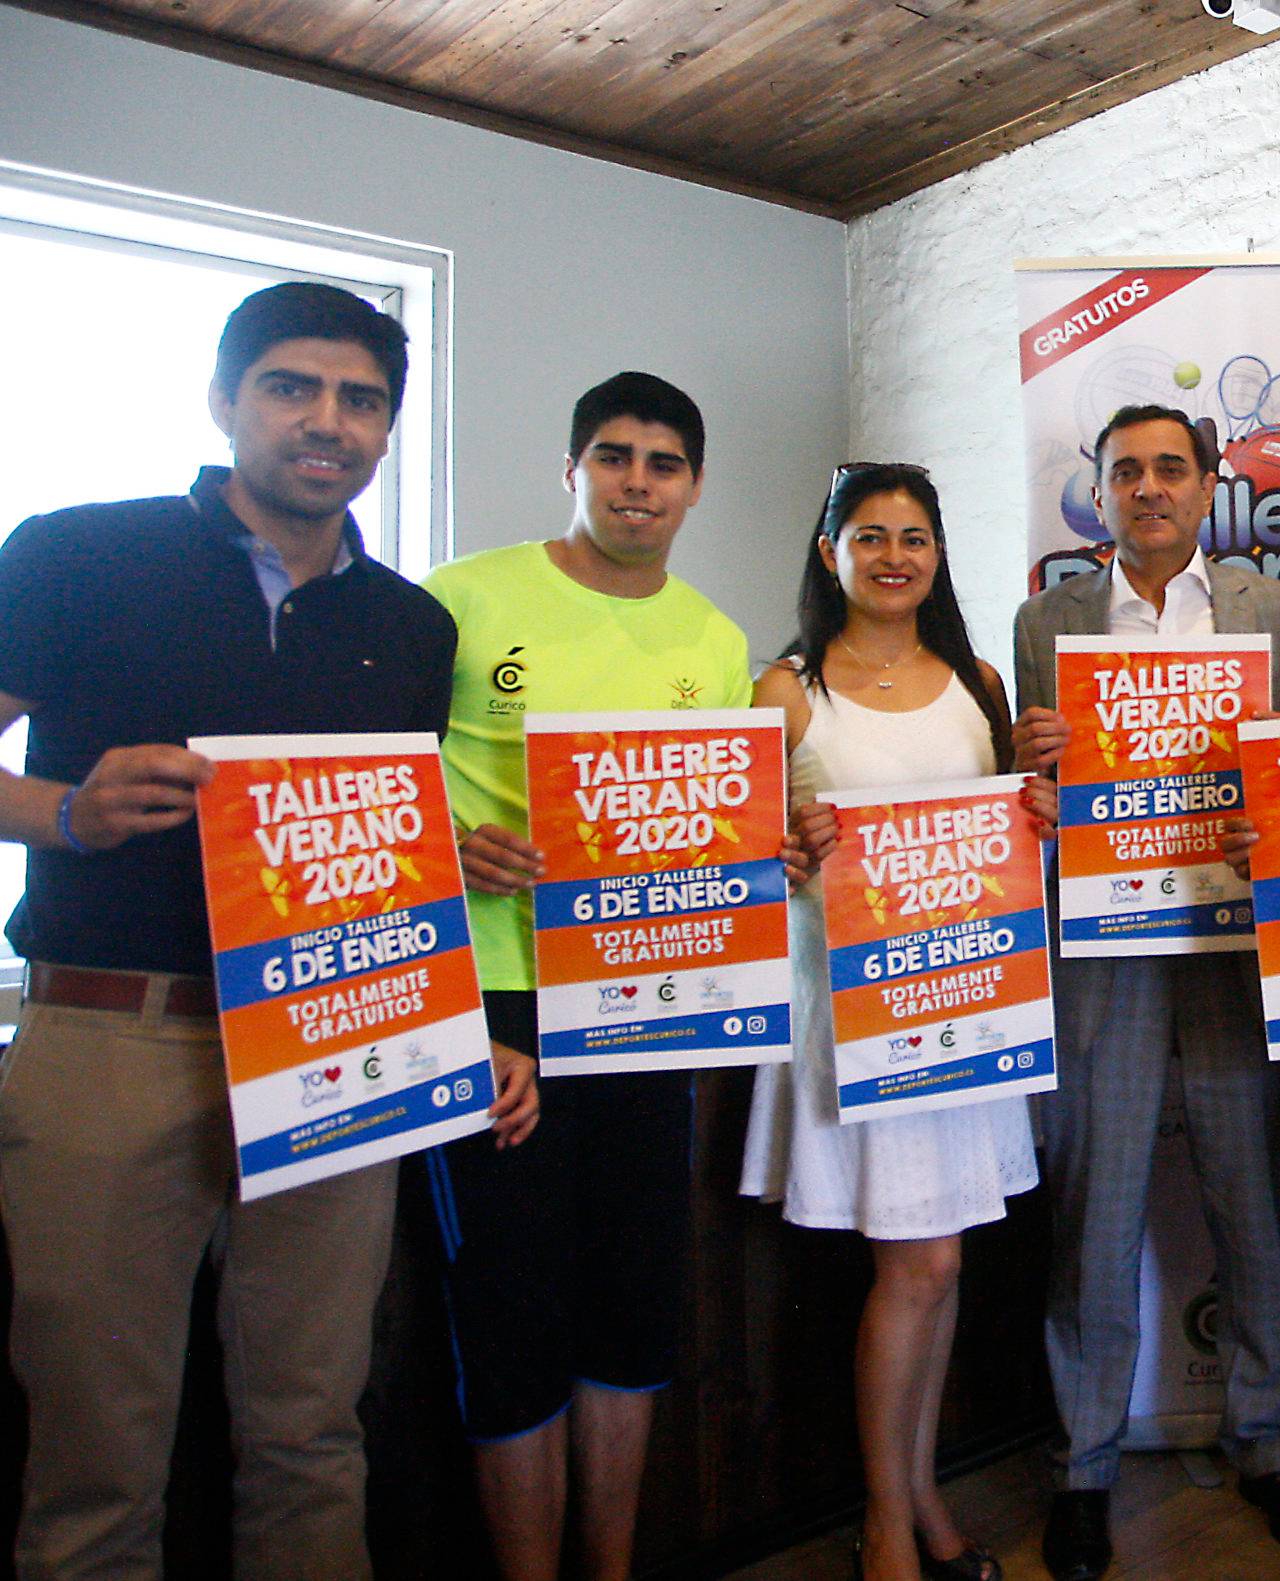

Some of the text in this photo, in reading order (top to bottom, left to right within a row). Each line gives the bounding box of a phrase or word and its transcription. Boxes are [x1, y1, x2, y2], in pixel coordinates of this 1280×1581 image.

[1034, 278, 1149, 356] GRATUITOS
[1094, 659, 1242, 700] TALLERES
[1095, 691, 1242, 731] VERANO
[572, 737, 751, 787] TALLERES
[1128, 726, 1210, 762] 2020
[248, 765, 419, 825] TALLERES
[574, 774, 750, 822] VERANO
[1091, 784, 1238, 820] 6 DE ENERO
[1115, 774, 1216, 793] INICIO TALLERES
[254, 805, 422, 867] VERANO
[615, 813, 714, 855] 2020
[858, 802, 1010, 856] TALLERES
[1107, 819, 1225, 846] TOTALMENTE
[1116, 836, 1217, 861] GRATUITOS
[302, 850, 397, 906] 2020
[601, 867, 722, 890] INICIO TALLERES
[861, 835, 1010, 887] VERANO
[573, 878, 748, 921] 6 DE ENERO
[898, 872, 981, 916] 2020
[1111, 879, 1129, 891] YO
[291, 910, 411, 950] INICIO TALLERES
[593, 917, 734, 949] TOTALMENTE
[887, 920, 991, 950] INICIO TALLERES
[262, 921, 437, 992] 6 DE ENERO
[603, 937, 725, 965] GRATUITOS
[864, 928, 1014, 979] 6 DE ENERO
[288, 968, 430, 1026] TOTALMENTE
[598, 987, 620, 999] YO
[882, 965, 1003, 1005] TOTALMENTE
[892, 984, 996, 1018] GRATUITOS
[302, 992, 424, 1043] GRATUITOS
[888, 1038, 908, 1050] YO
[299, 1071, 324, 1088] YO
